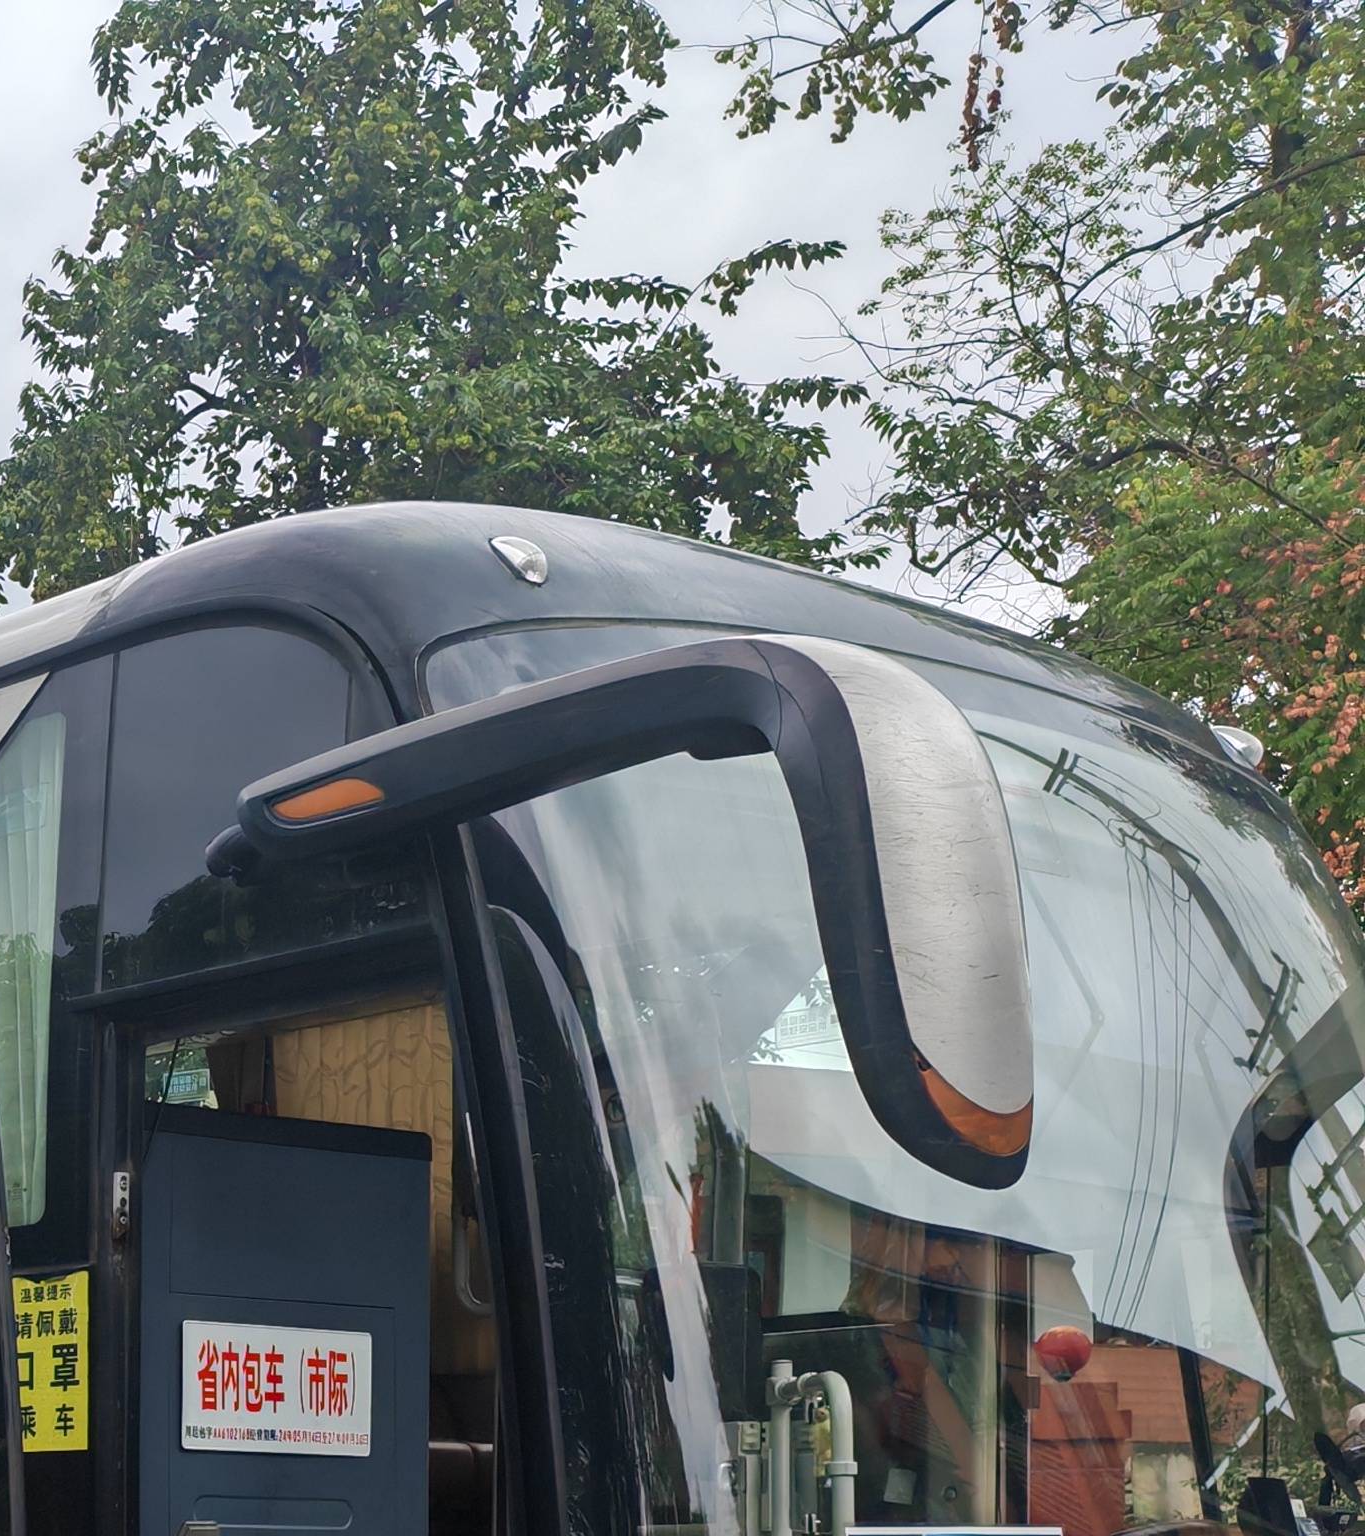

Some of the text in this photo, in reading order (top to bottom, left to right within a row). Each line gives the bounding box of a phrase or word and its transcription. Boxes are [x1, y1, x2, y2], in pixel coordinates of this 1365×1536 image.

[20, 1284, 72, 1303] 温馨提示
[16, 1307, 78, 1339] 请佩戴
